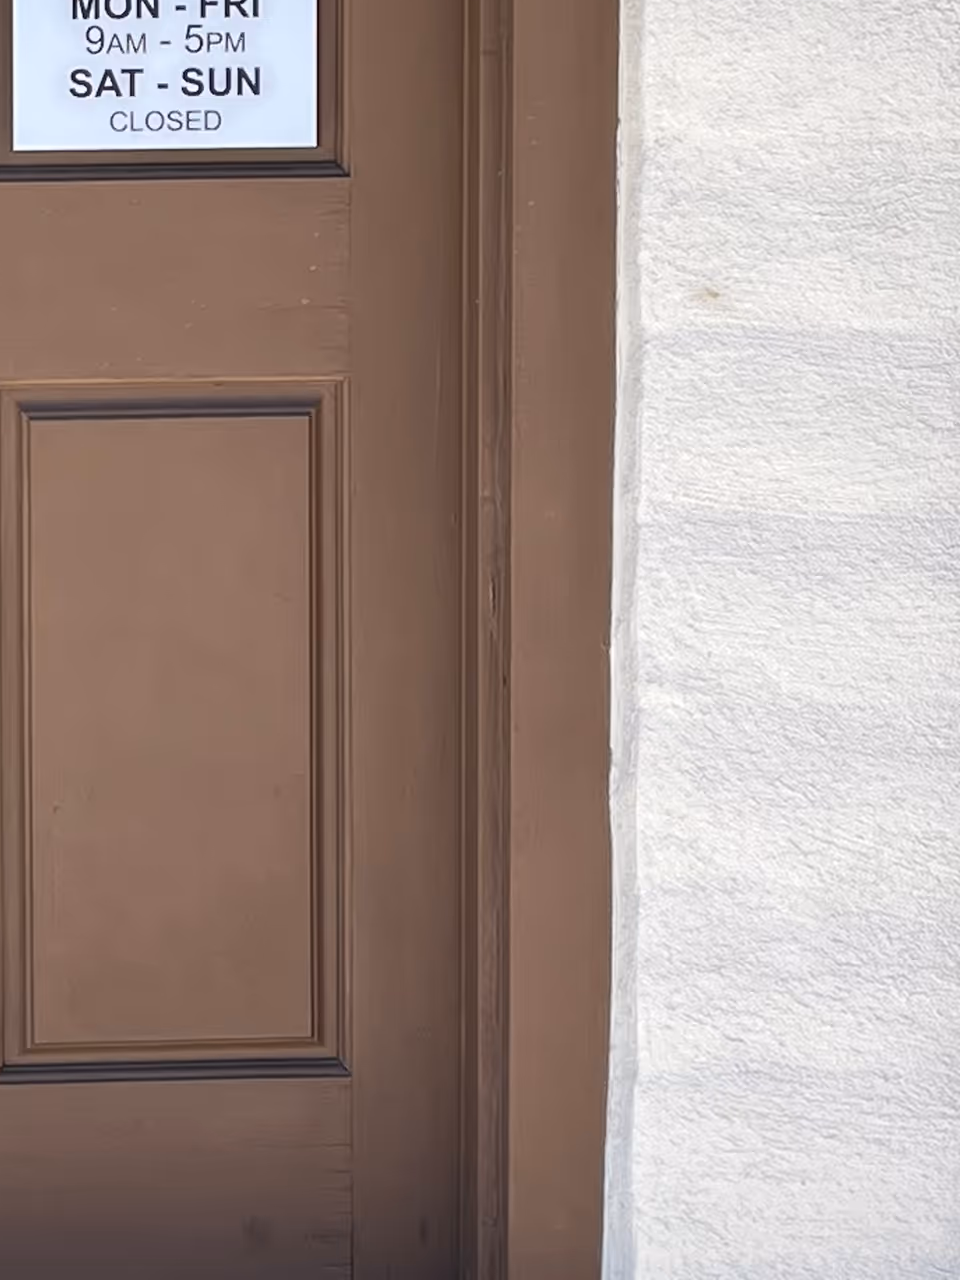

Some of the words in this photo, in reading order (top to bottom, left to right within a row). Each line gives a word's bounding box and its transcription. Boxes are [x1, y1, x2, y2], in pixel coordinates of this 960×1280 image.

[85, 25, 146, 55] 9AM
[185, 24, 245, 53] 5PM
[69, 68, 144, 98] SAT
[181, 67, 260, 96] SUN
[110, 110, 221, 132] CLOSED
